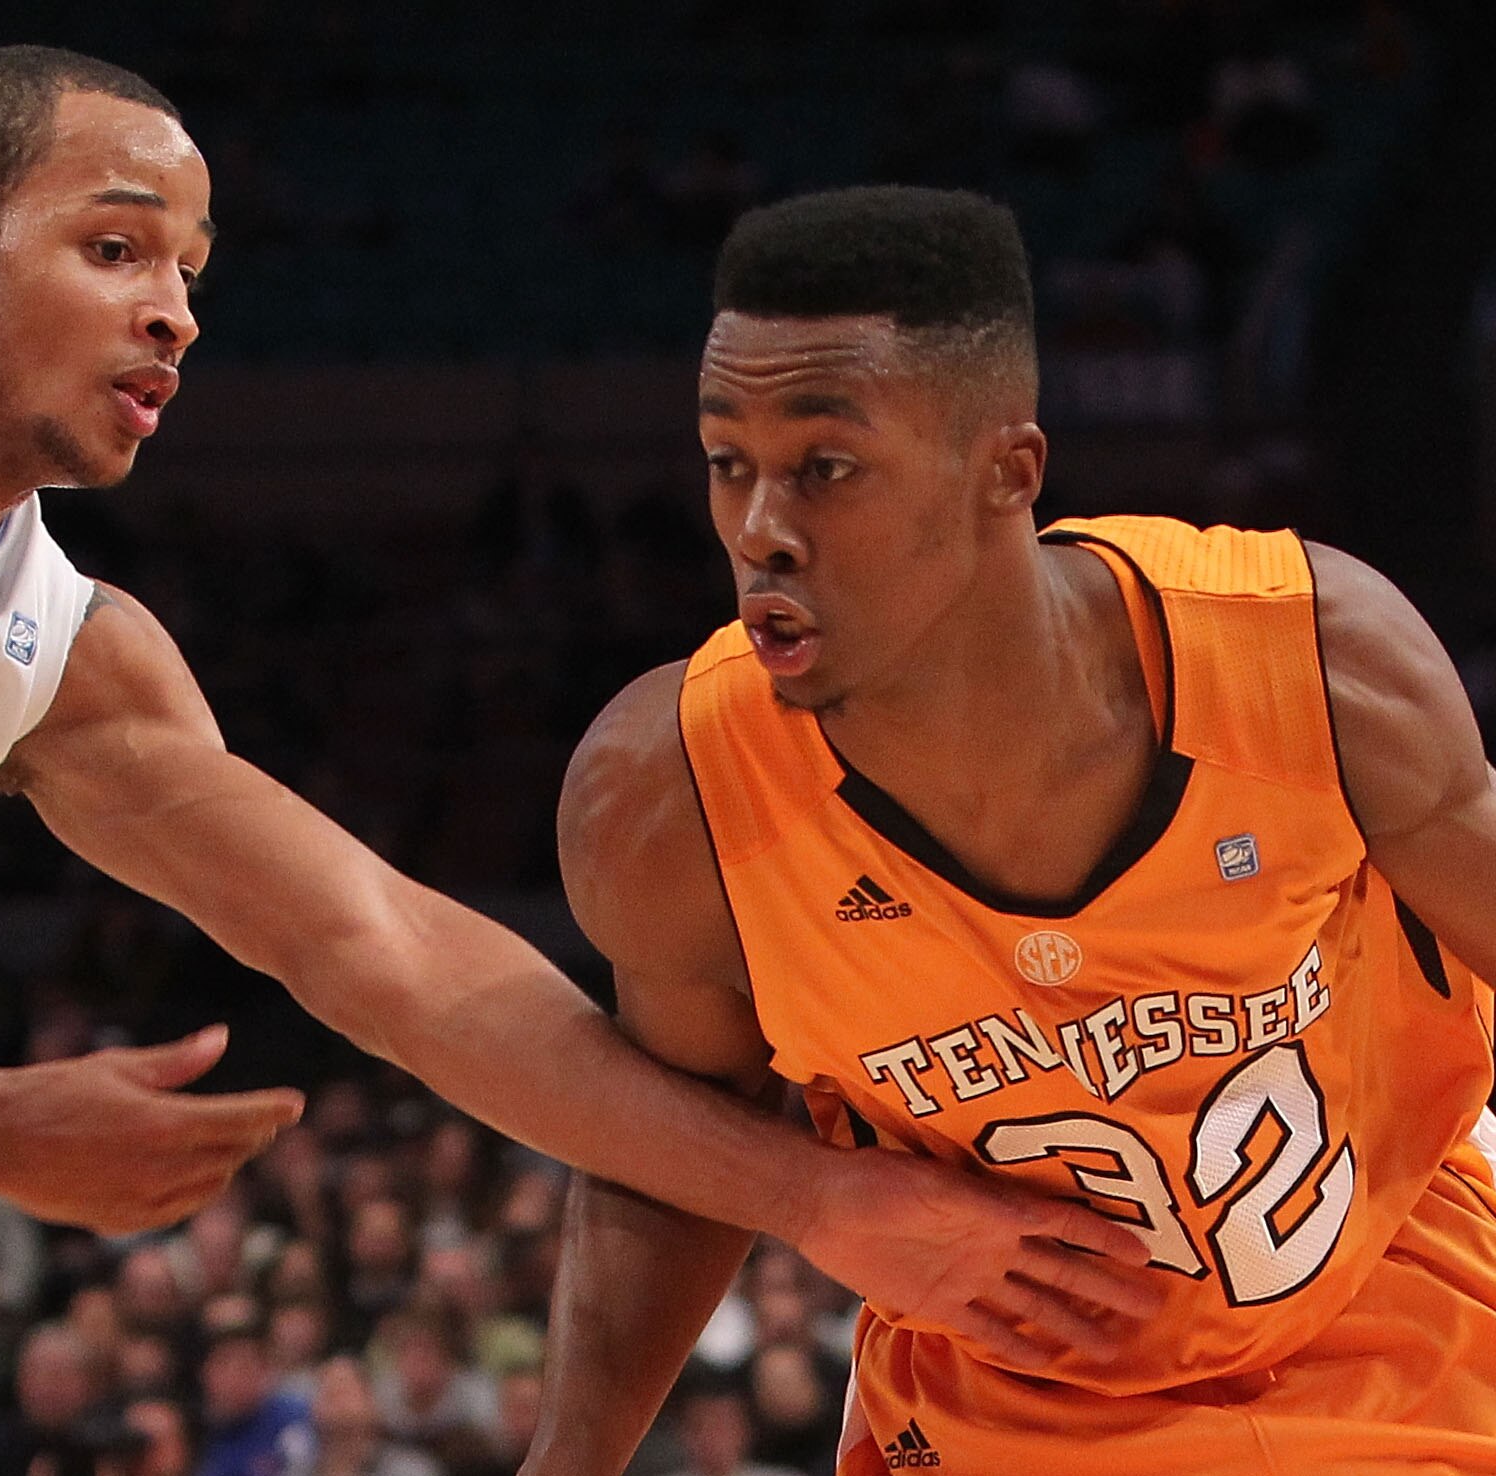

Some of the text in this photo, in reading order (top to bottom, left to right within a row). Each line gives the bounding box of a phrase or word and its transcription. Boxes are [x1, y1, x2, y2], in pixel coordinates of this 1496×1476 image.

[835, 902, 912, 921] adidas
[1020, 933, 1077, 982] SEC
[972, 1039, 1355, 1308] 32
